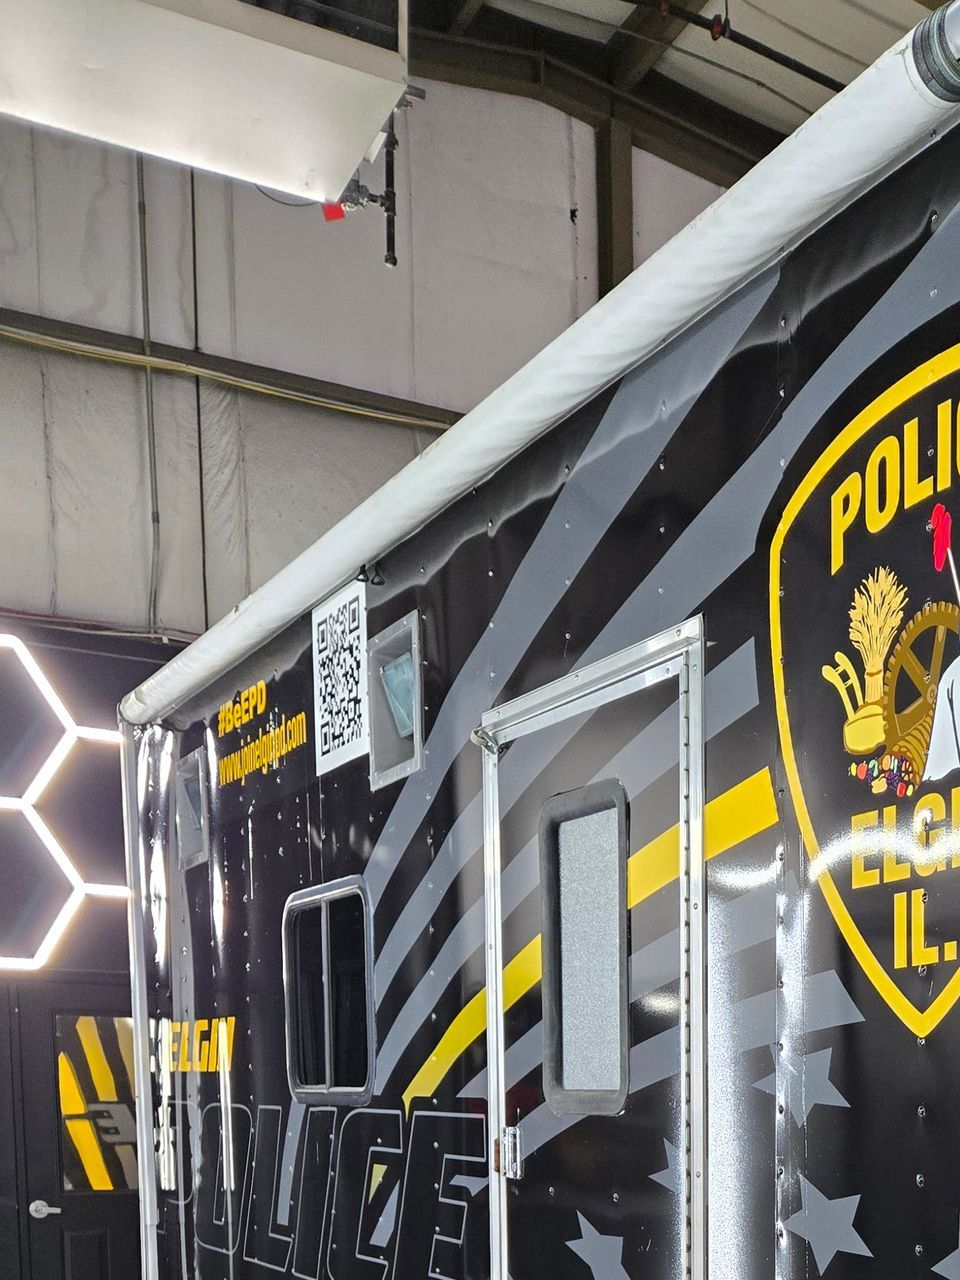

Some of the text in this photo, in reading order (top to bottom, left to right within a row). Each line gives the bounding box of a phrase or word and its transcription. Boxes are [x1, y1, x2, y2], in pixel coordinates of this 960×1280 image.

[218, 680, 266, 737] #BeEPD
[894, 888, 957, 969] IL.
[169, 1016, 236, 1072] ELGIN
